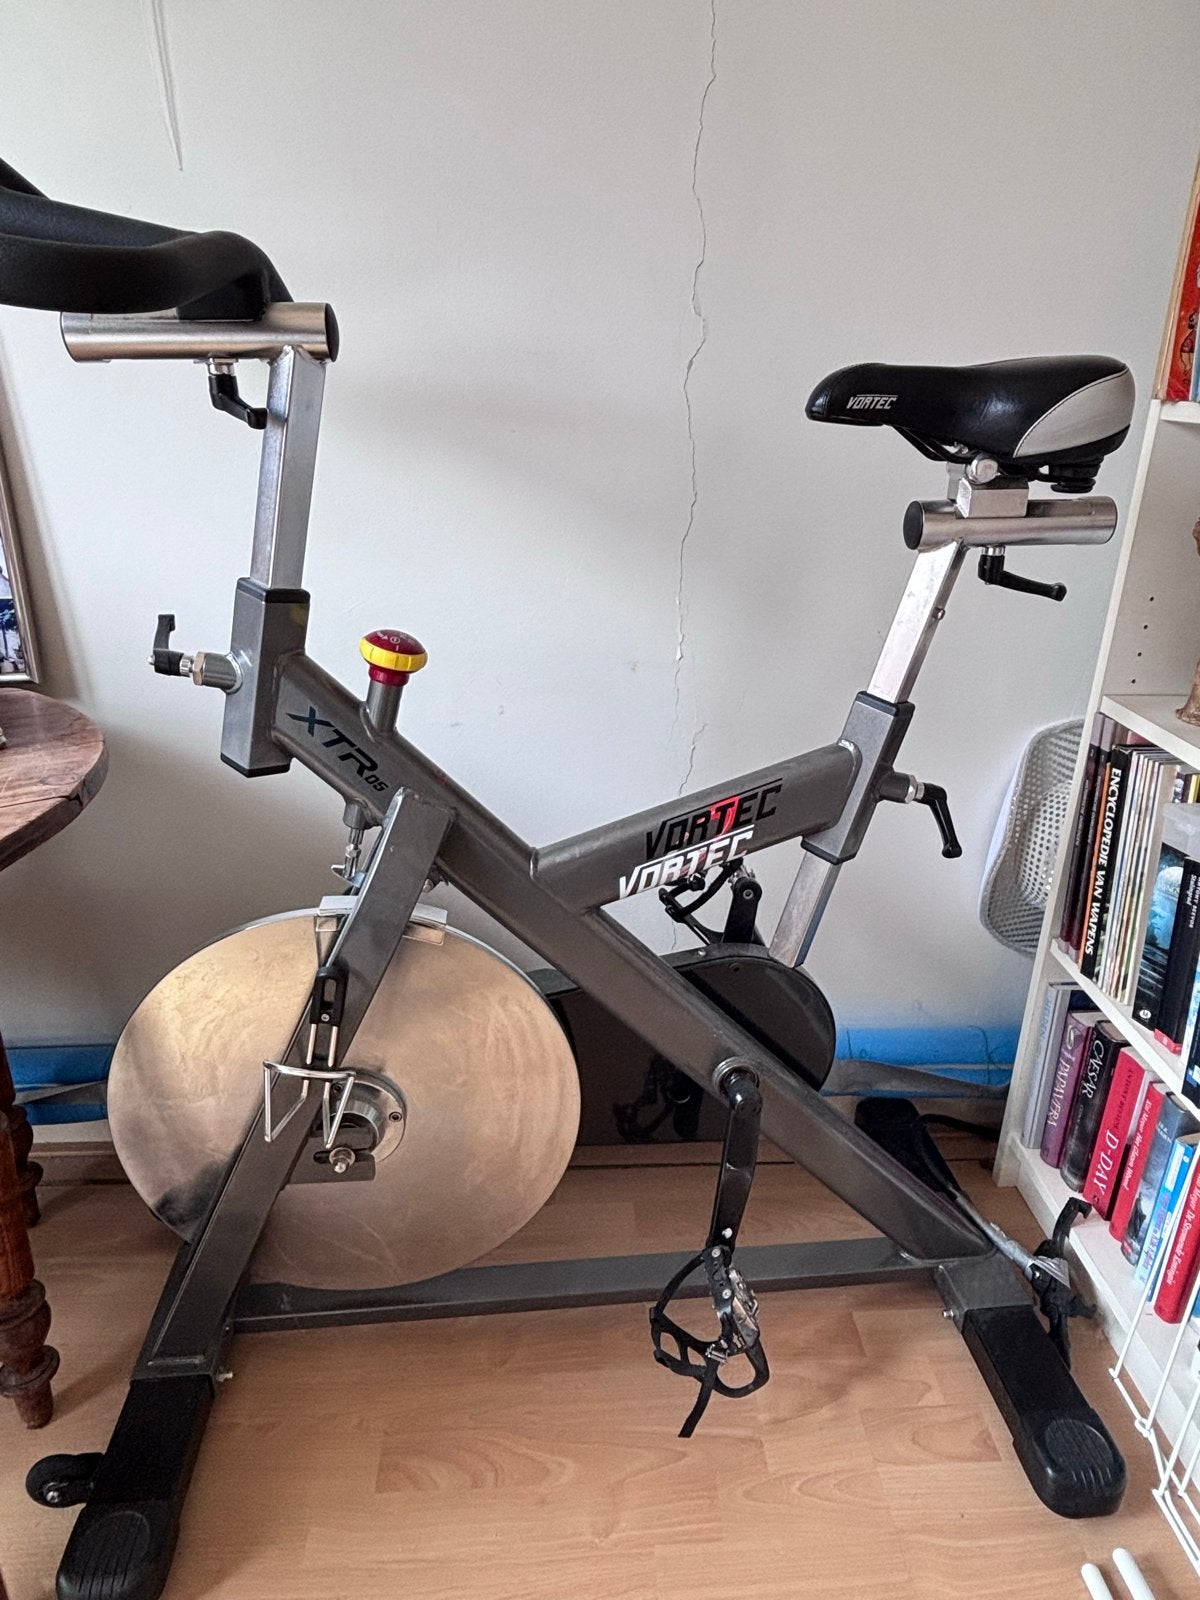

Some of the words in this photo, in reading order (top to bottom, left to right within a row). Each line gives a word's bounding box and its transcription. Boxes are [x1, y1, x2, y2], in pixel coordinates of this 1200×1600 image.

[847, 394, 898, 410] VORTEC
[646, 778, 783, 861] VORTEC
[1098, 767, 1122, 868] ENCYCLOPEDIE
[619, 824, 755, 900] VORTEC
[1093, 870, 1106, 899] VAN
[1085, 902, 1100, 956] WAPENS
[1081, 1039, 1105, 1099] CAESAR
[1094, 1129, 1119, 1196] D-DAY
